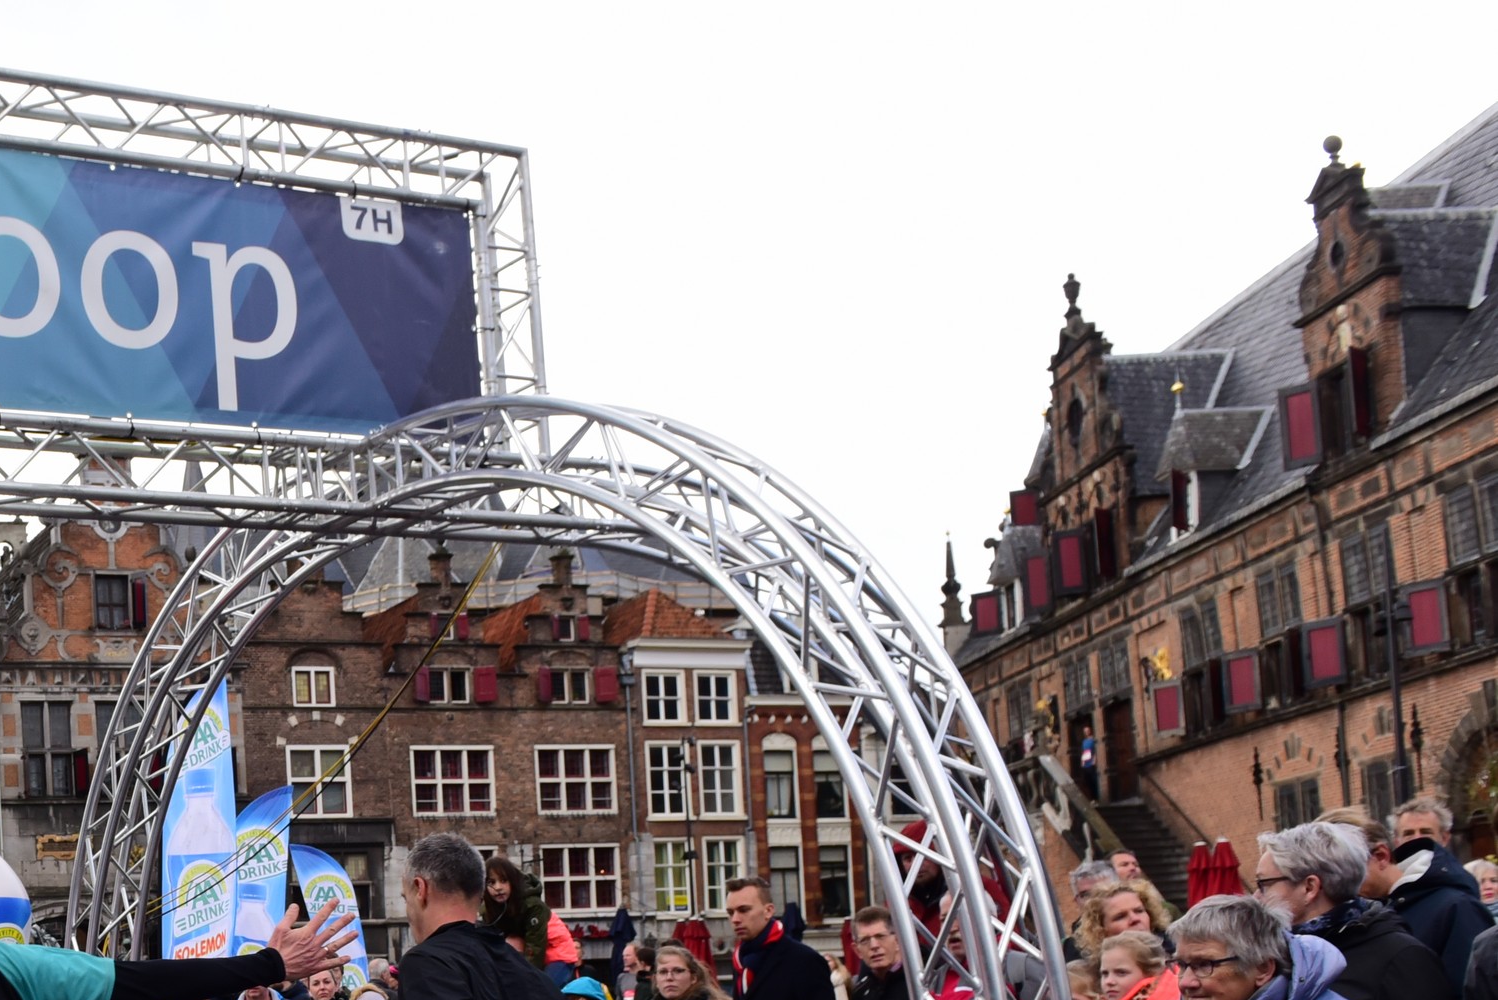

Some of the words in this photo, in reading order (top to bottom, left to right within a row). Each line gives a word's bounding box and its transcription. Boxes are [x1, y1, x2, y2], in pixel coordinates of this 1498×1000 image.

[350, 204, 393, 235] 7H
[189, 739, 222, 767] DRINK
[237, 861, 282, 880] DRINK
[192, 879, 220, 910] AA
[187, 901, 225, 928] DRINK
